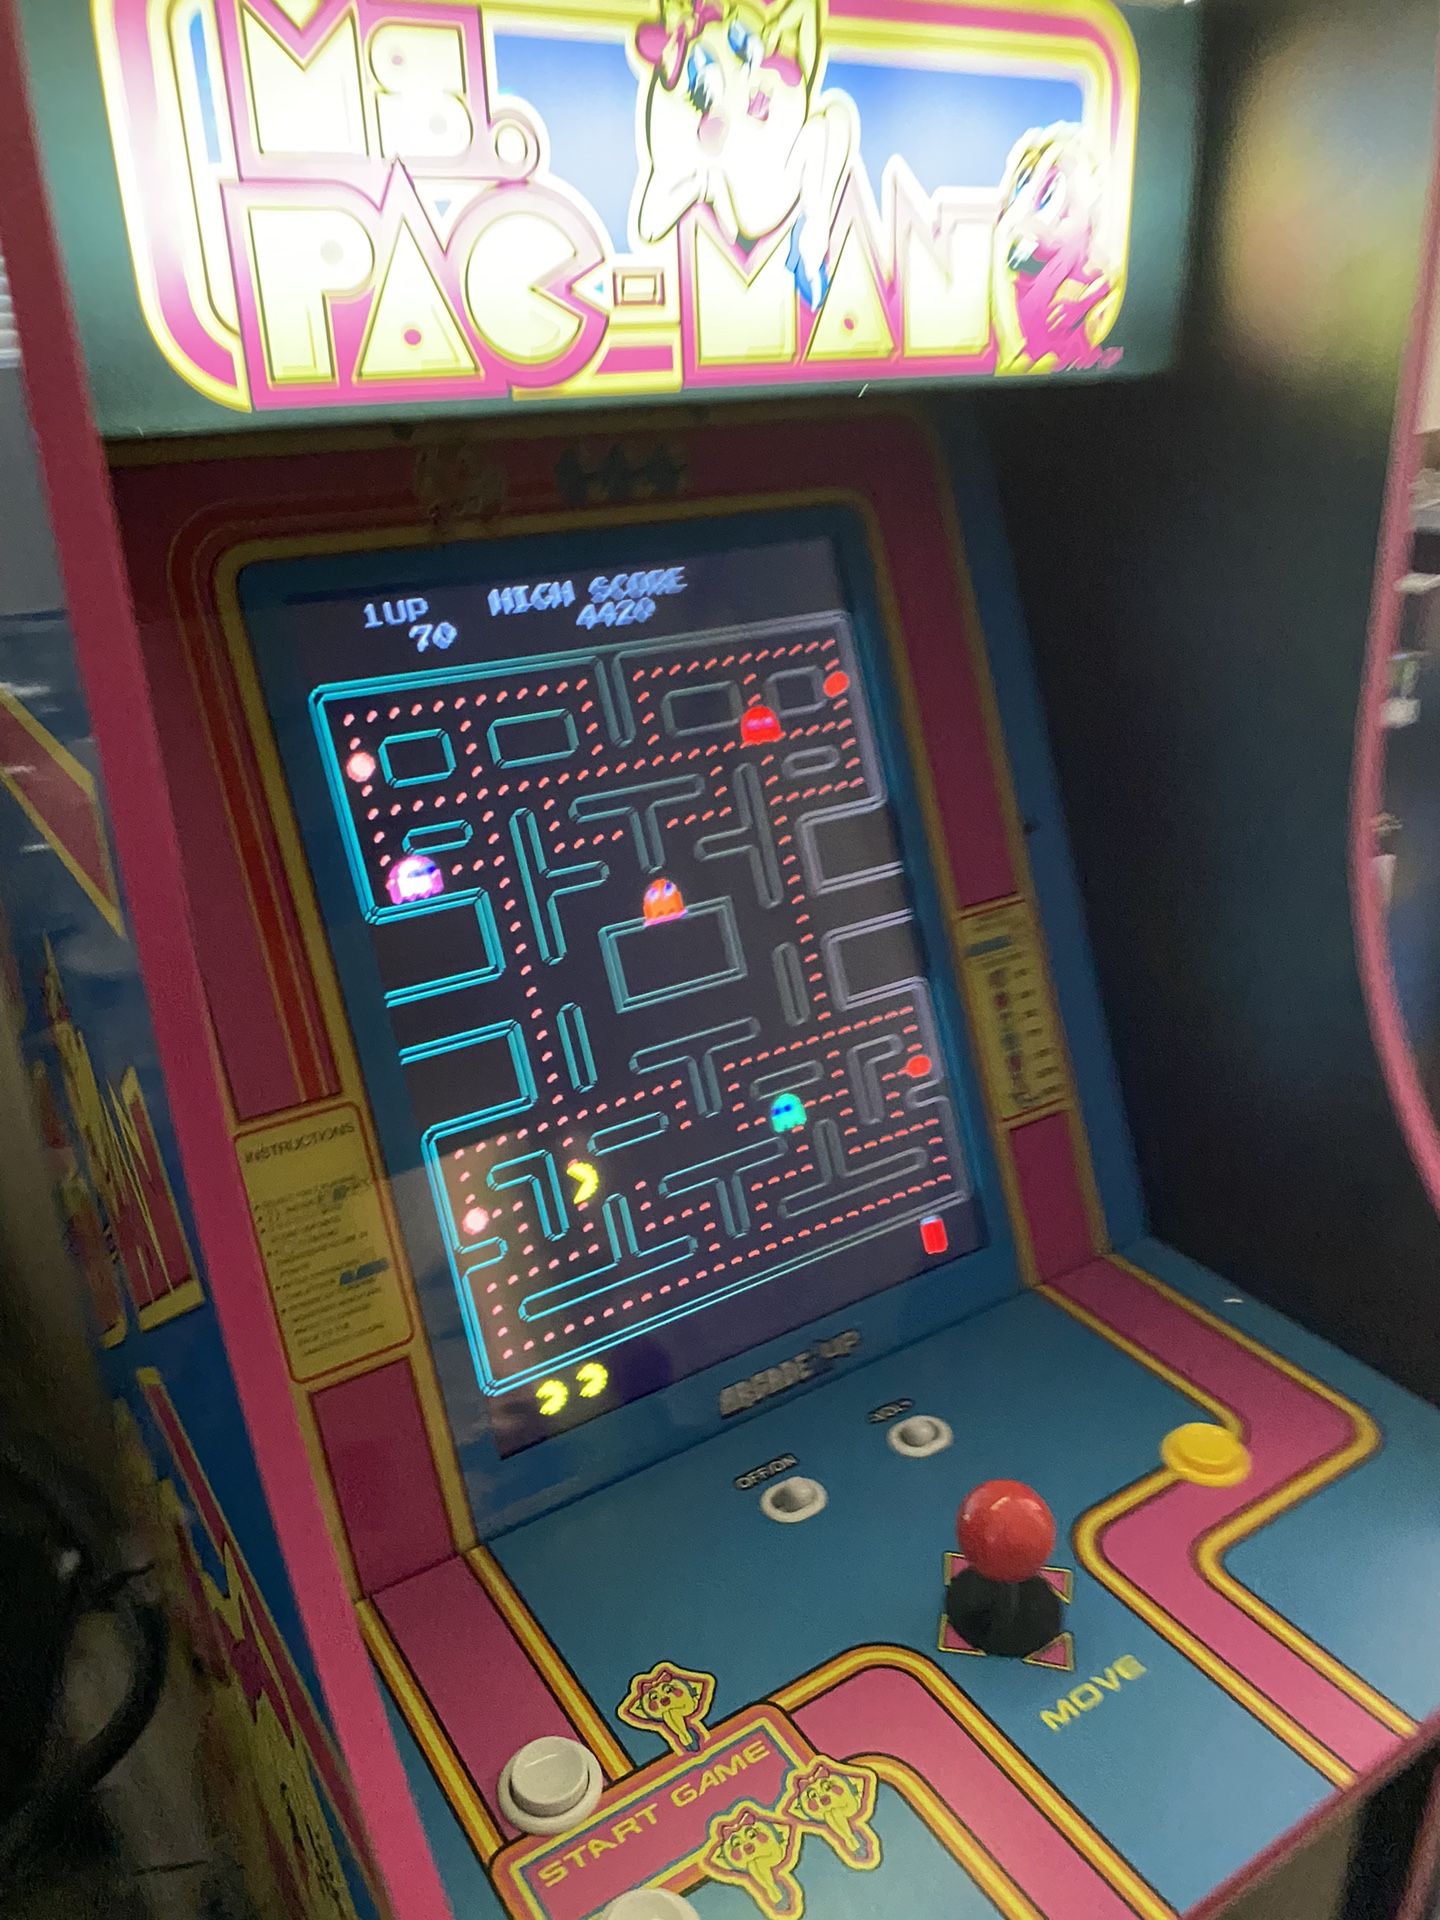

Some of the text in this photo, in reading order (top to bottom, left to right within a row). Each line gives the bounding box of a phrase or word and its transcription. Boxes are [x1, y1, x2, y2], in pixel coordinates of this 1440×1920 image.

[488, 566, 688, 617] HIGH SCORE
[363, 597, 429, 629] 1UP
[576, 597, 657, 630] 4420
[408, 621, 459, 653] 70
[1040, 1653, 1148, 1732] MOVE
[538, 1740, 770, 1888] START GAME
